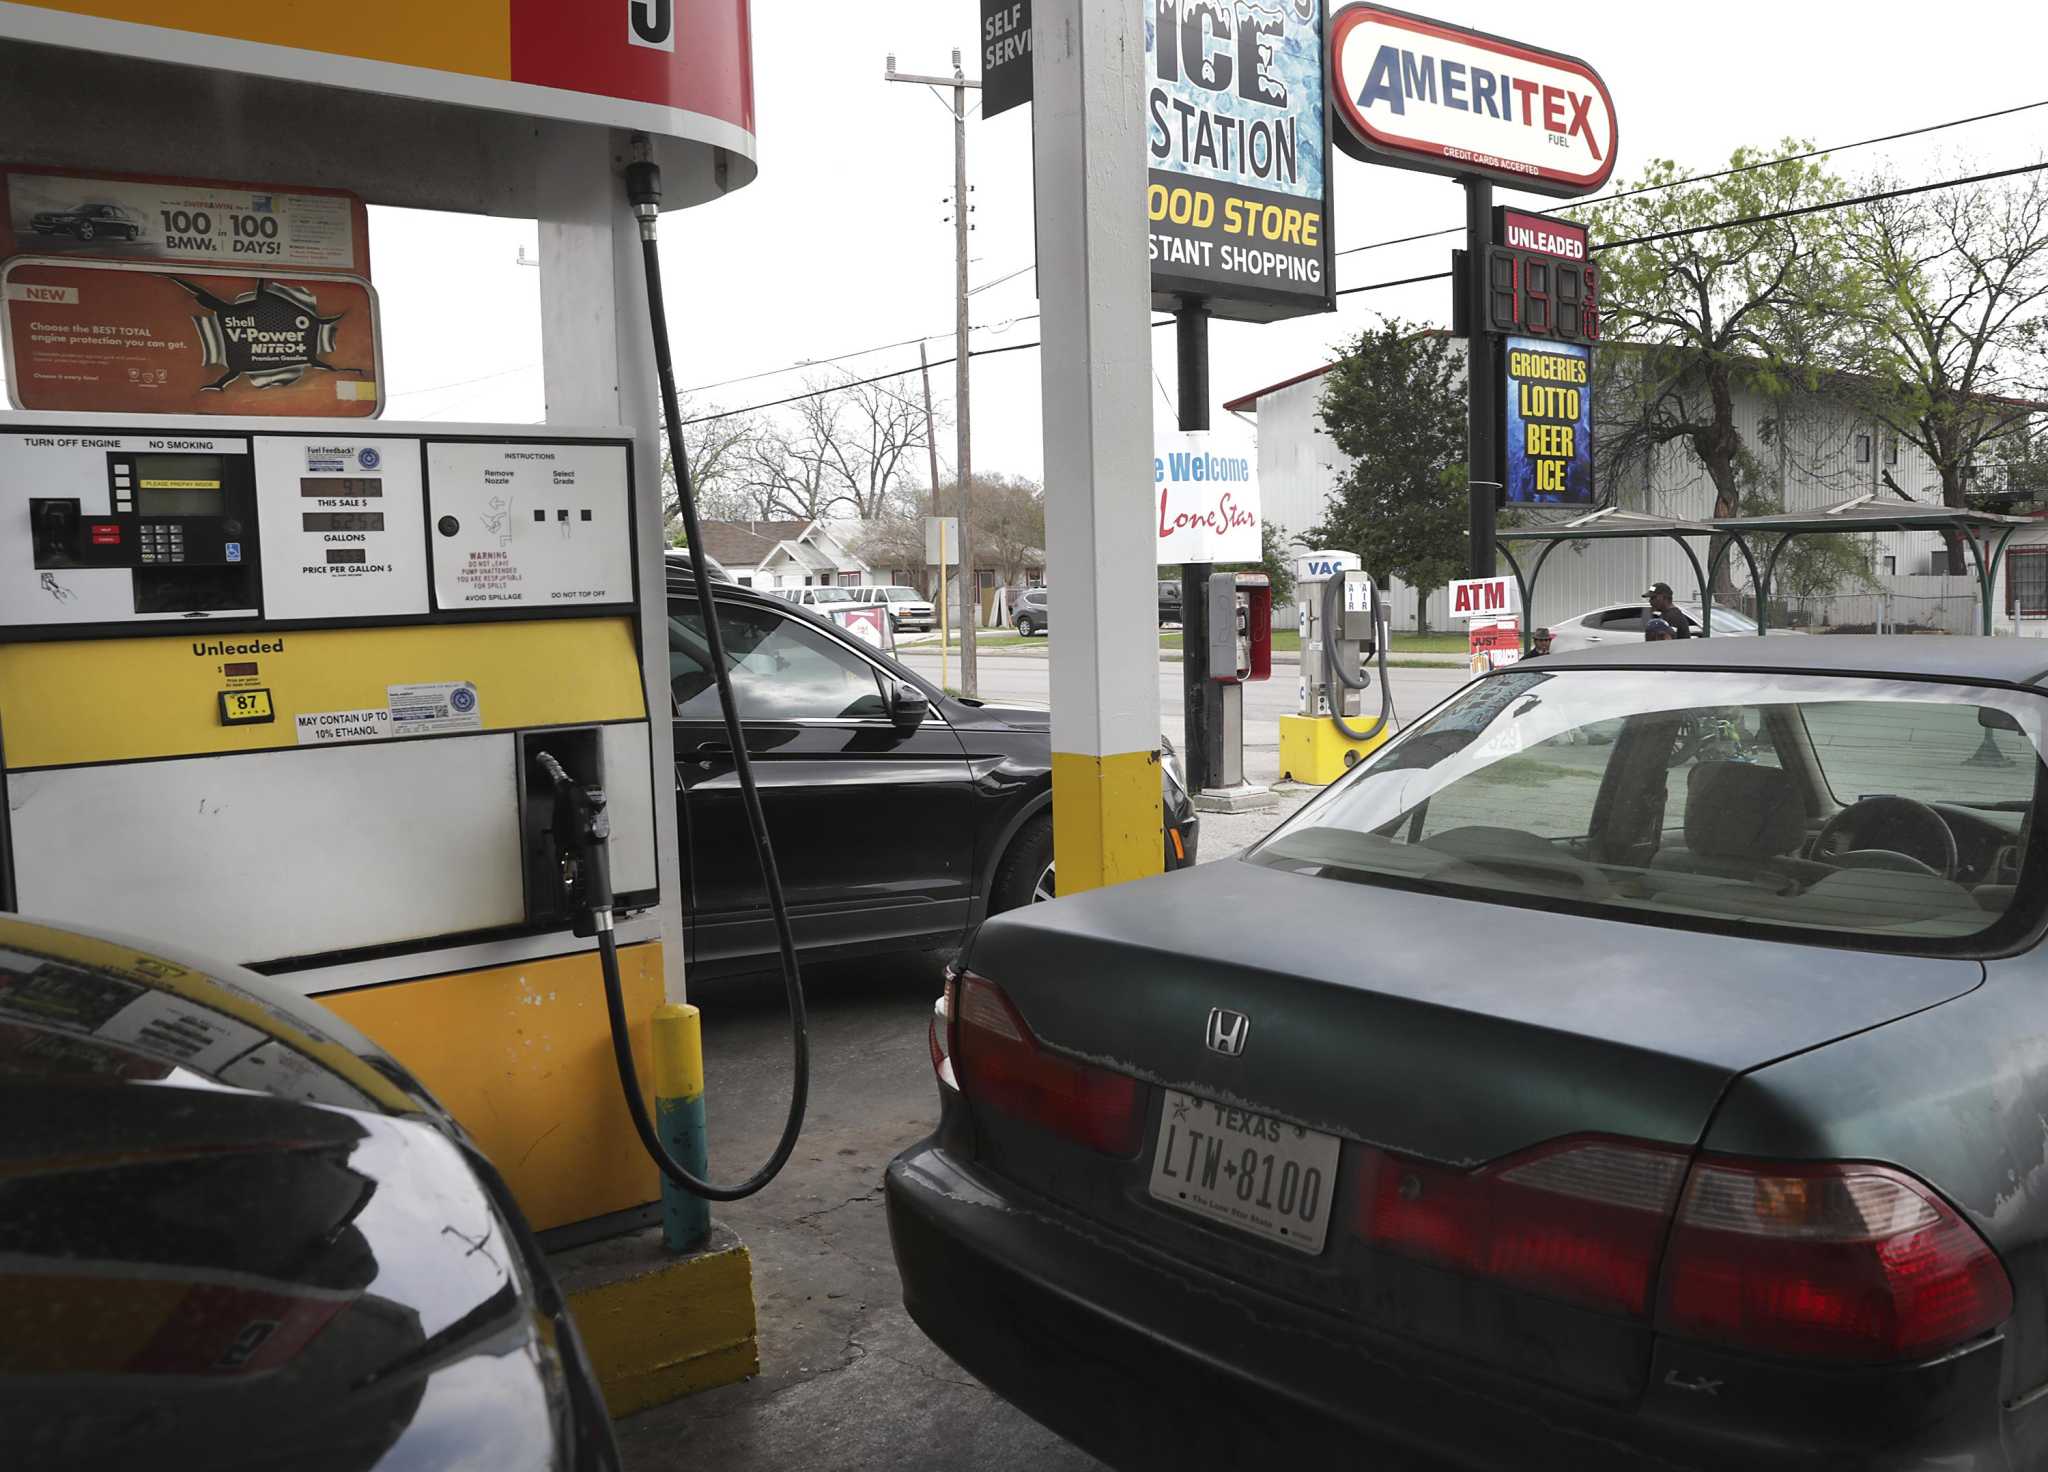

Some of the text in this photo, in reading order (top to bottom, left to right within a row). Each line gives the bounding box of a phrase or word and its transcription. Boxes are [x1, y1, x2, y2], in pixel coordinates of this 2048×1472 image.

[985, 3, 1021, 40] SELF
[1154, 0, 1288, 109] ICE
[1356, 44, 1603, 162] AMERITEX
[1150, 87, 1298, 185] STATION
[1548, 134, 1570, 148] FUEL
[1443, 147, 1540, 175] CREDIT CARDS ACCEPTED
[1148, 184, 1321, 247] OOD STORE
[160, 210, 212, 234] 100
[229, 214, 279, 239] 100
[232, 239, 281, 255] DAYS!
[1508, 225, 1584, 259] UNLEADED
[1149, 234, 1321, 283] STANT SHOPPING
[26, 287, 66, 301] NEW
[30, 322, 152, 337] Choose the BEST TOTAL
[225, 316, 255, 327] Shell
[31, 333, 188, 350] engine protection you can get.
[226, 328, 305, 342] V-Power
[1510, 352, 1587, 384] GROCERIES
[1521, 384, 1579, 420] LOTTO
[24, 438, 121, 448] TURN OFF ENGINE
[149, 440, 214, 450] NO SMOKING
[1527, 424, 1574, 457] BEER
[484, 469, 515, 477] Remove
[553, 470, 575, 478] Select
[1168, 451, 1249, 481] Welcome
[485, 477, 510, 485] Nozzle
[1536, 460, 1566, 491] ICE
[318, 499, 337, 507] THIS
[339, 499, 359, 507] SALE
[324, 534, 367, 542] GALLONS
[469, 552, 508, 560] WARNING
[302, 566, 327, 574] PRICE
[348, 565, 385, 573] GALLON
[1308, 562, 1343, 575] VAC
[1454, 581, 1505, 612] ATM
[193, 638, 284, 657] Unleaded
[1472, 636, 1498, 647] JUST
[237, 695, 256, 710] 87
[298, 712, 388, 727] MAY CONTAIN UP TO
[316, 726, 378, 739] 10% ETHANOL
[1213, 1103, 1281, 1143] TEXAS
[1209, 1200, 1229, 1213] Lone
[1231, 1208, 1248, 1220] Star
[1664, 1369, 1724, 1396] LX
